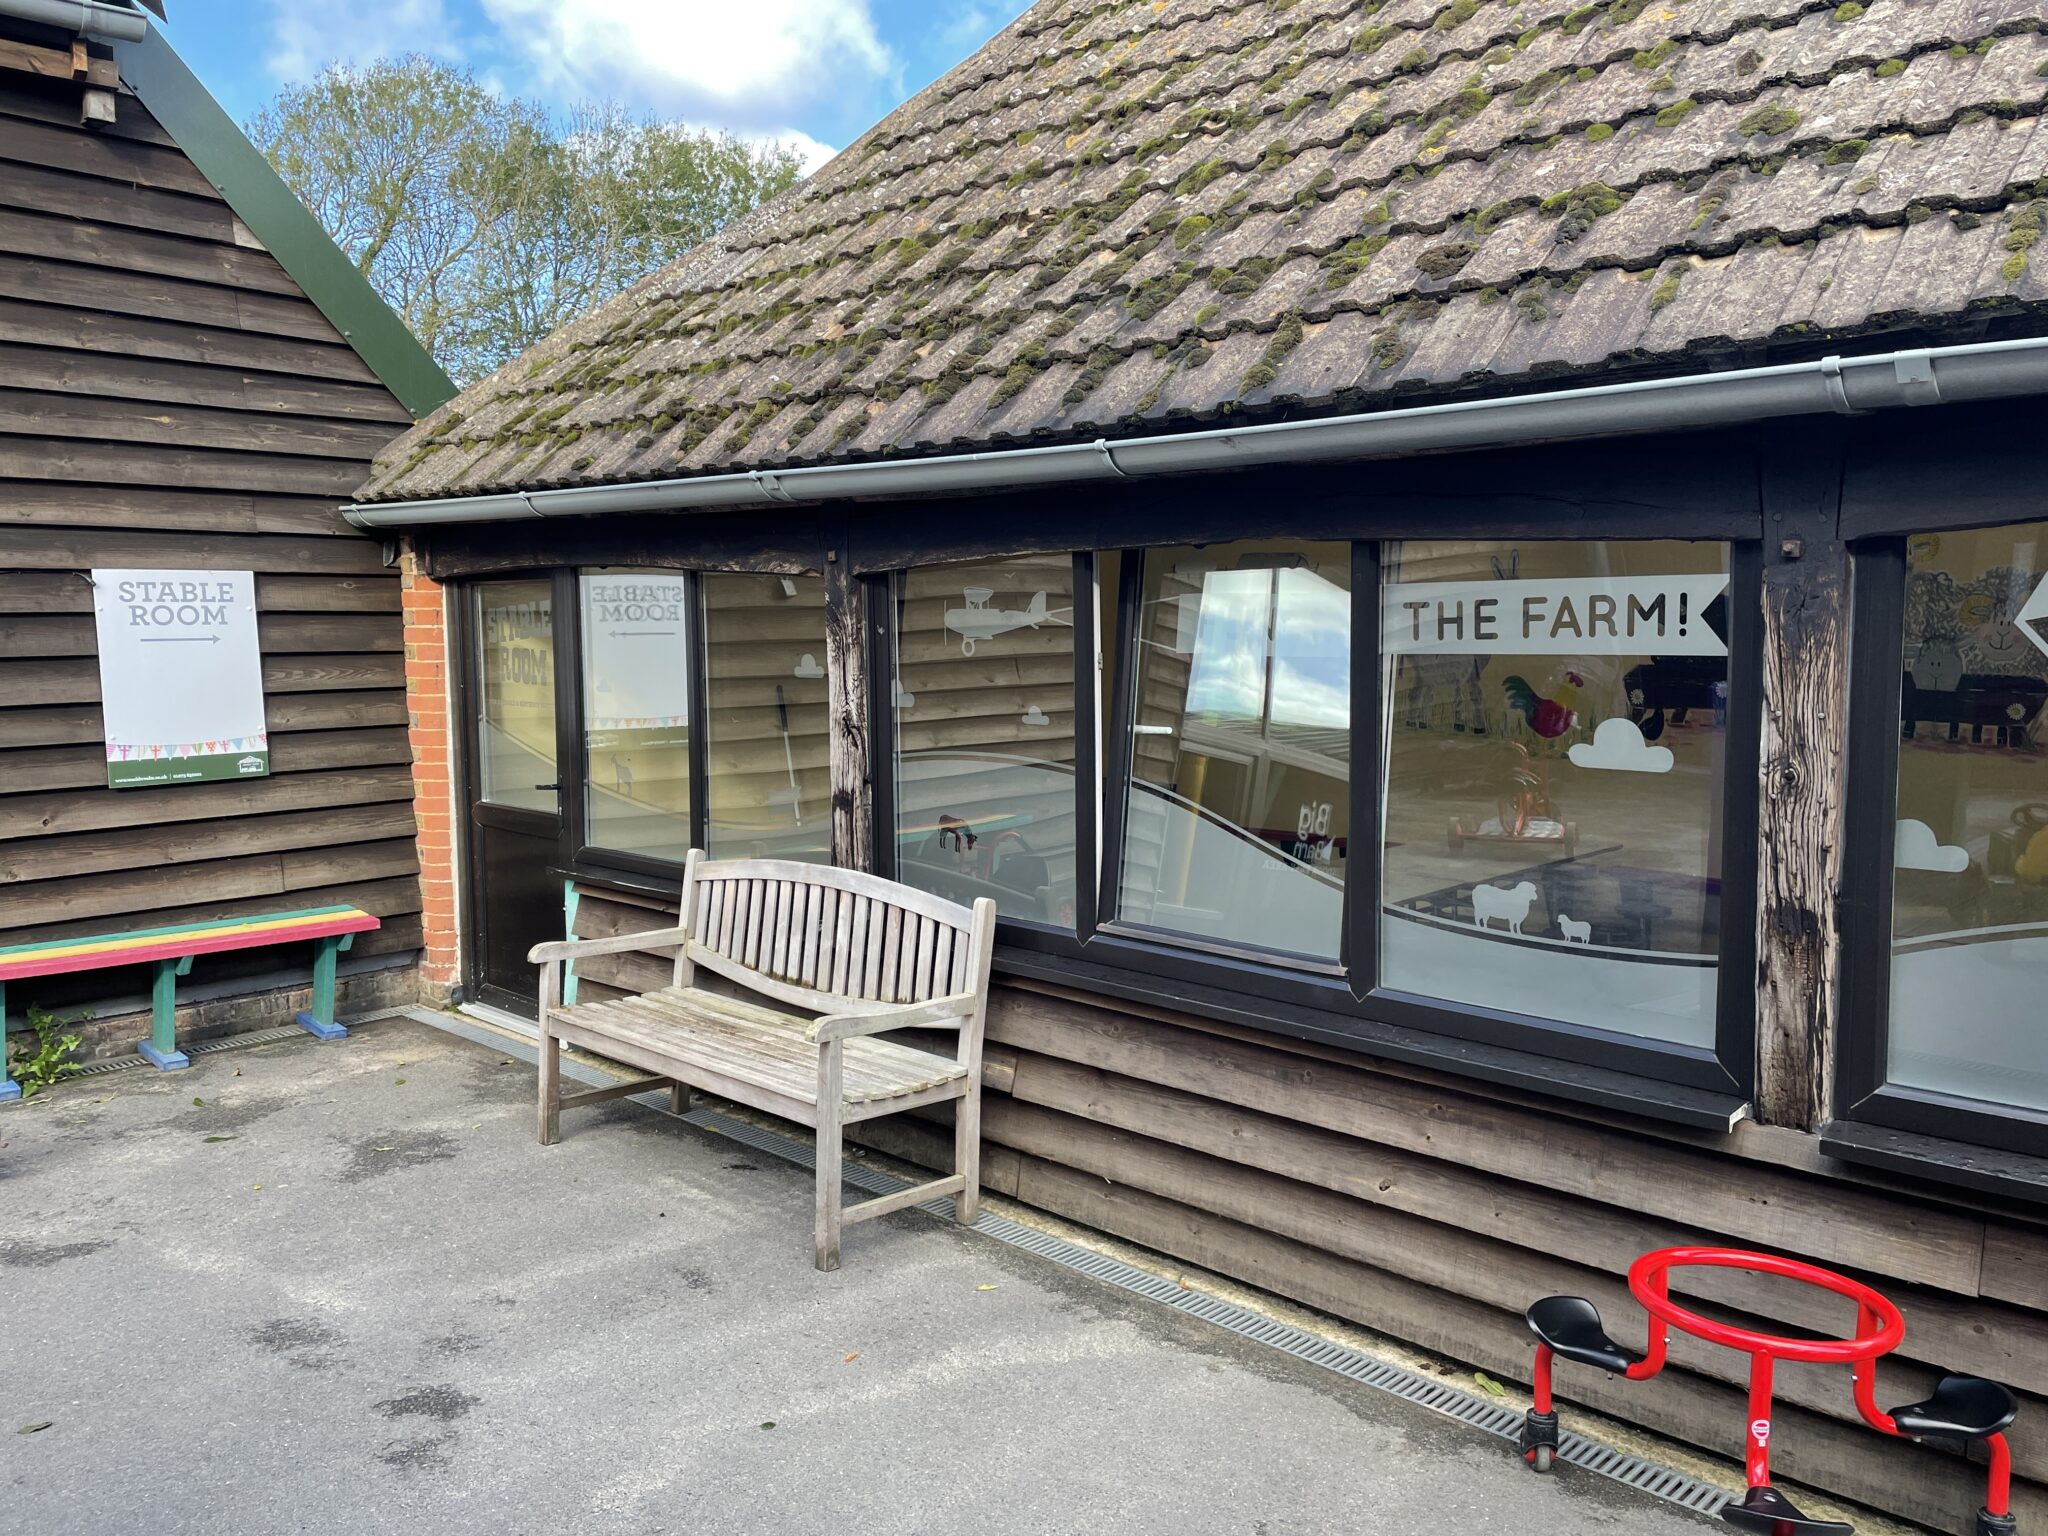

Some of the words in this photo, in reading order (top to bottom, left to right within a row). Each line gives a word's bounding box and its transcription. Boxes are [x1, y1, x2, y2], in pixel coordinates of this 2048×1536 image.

[118, 581, 234, 603] STABLE
[129, 605, 229, 626] ROOM
[1403, 599, 1498, 641] THE
[1522, 592, 1688, 639] FARM!
[500, 646, 547, 687] ROOM
